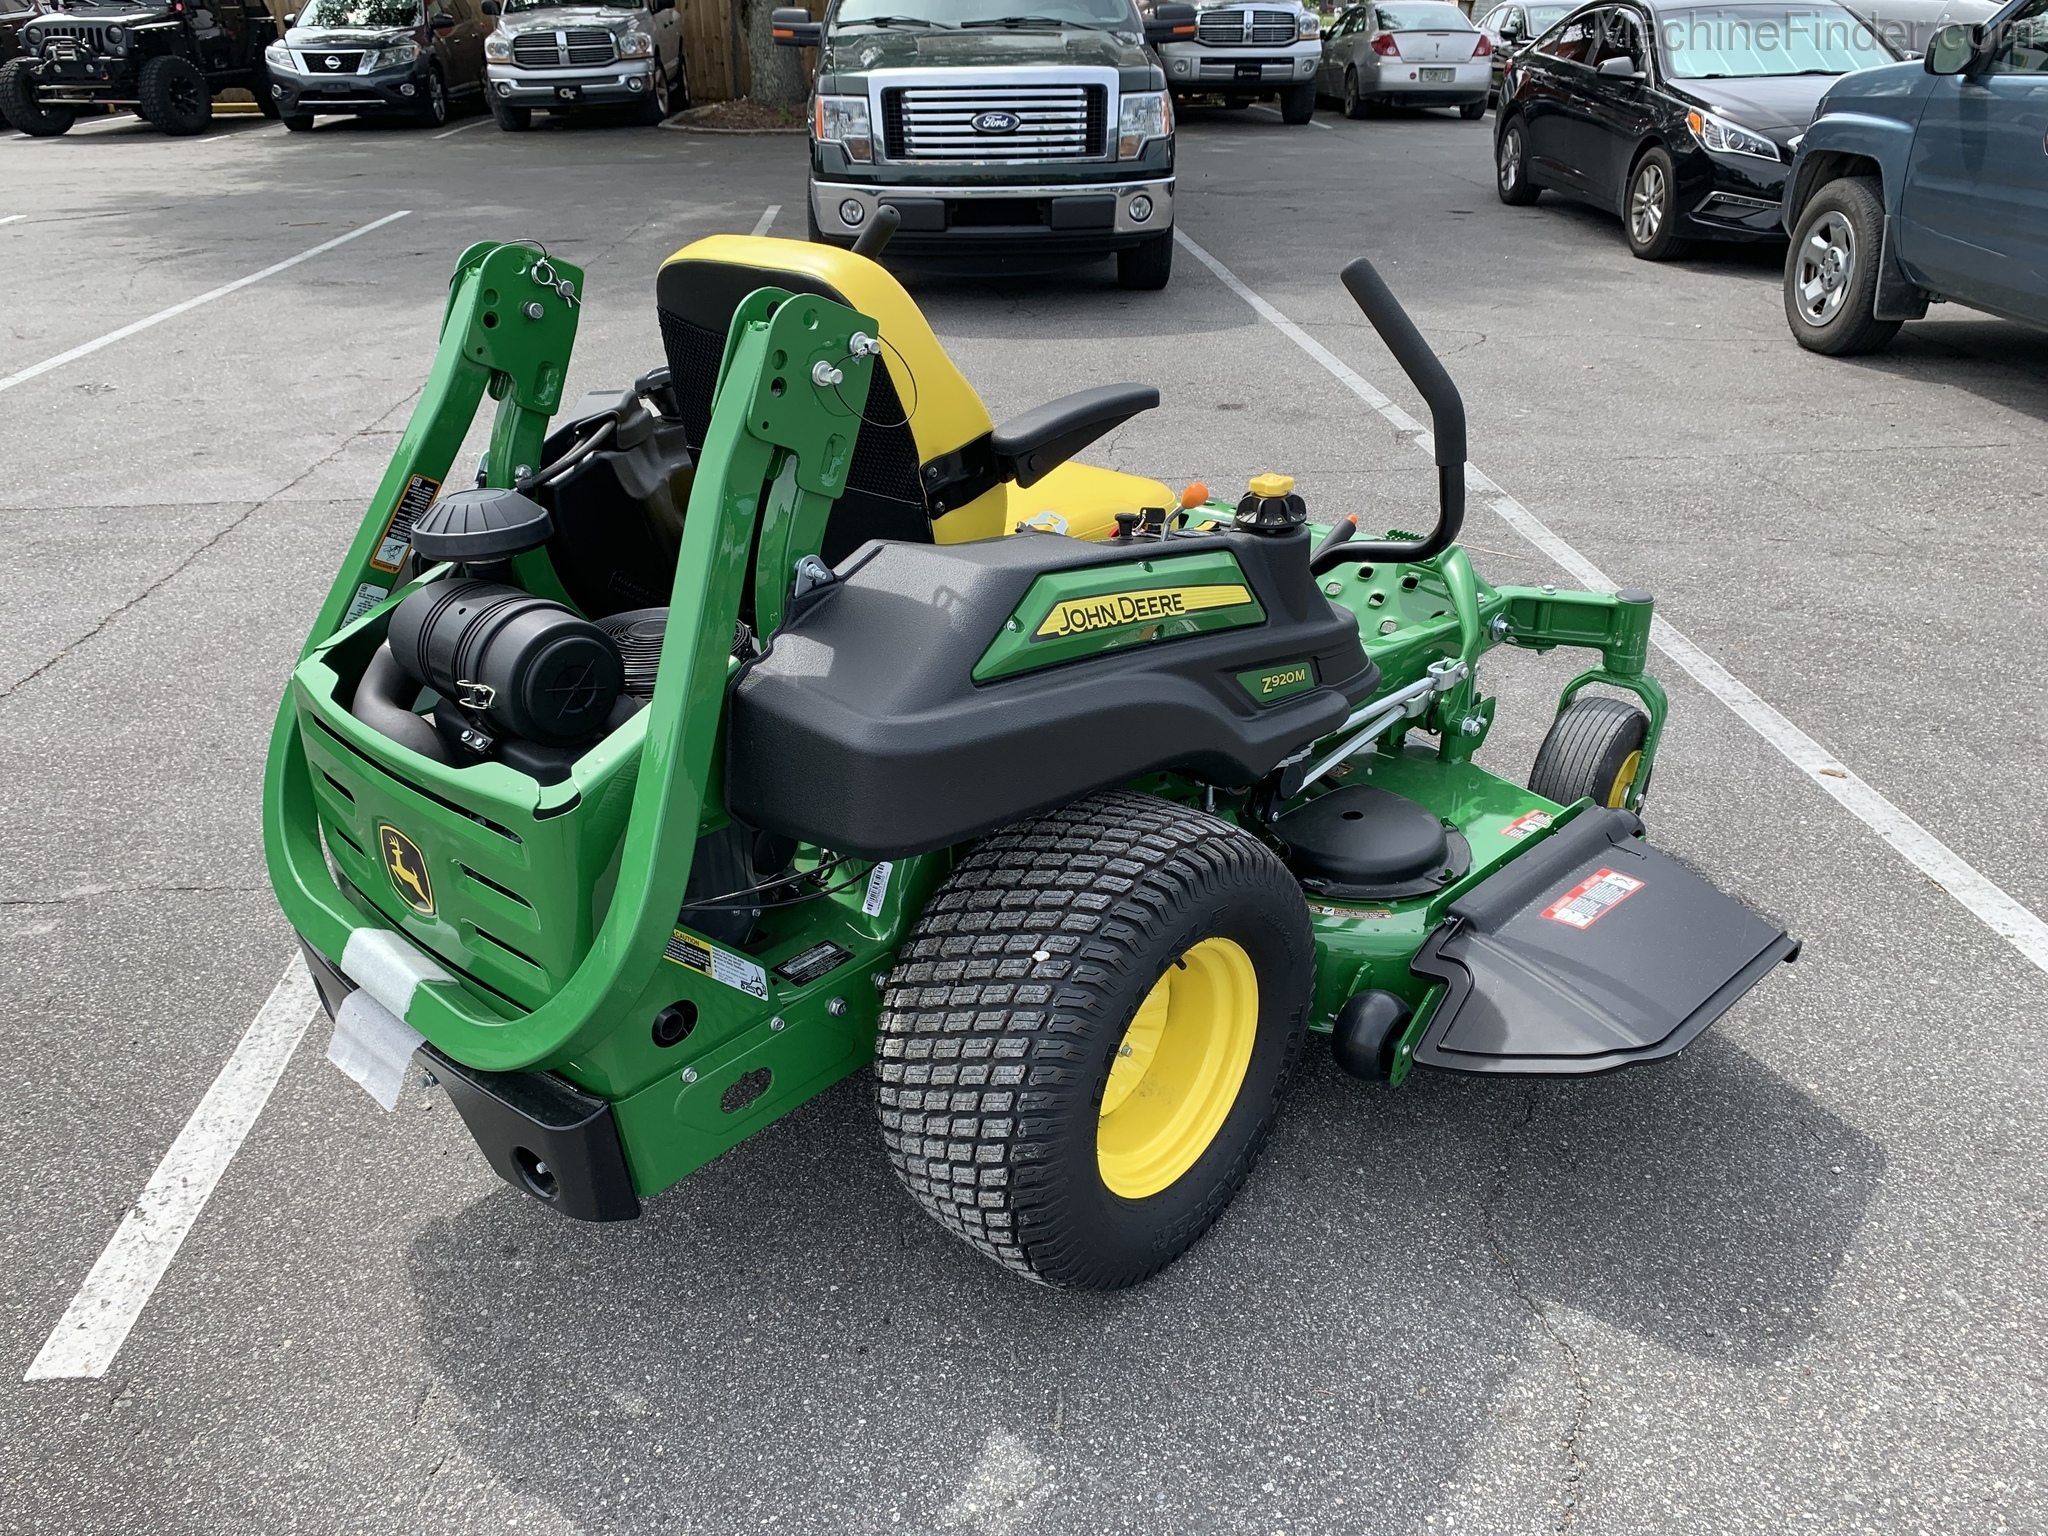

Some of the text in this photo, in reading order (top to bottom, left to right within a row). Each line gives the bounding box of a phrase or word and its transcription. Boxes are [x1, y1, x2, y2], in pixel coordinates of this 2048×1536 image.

[982, 114, 1009, 128] Ford
[1059, 593, 1185, 632] JOHN DEERE
[1261, 668, 1306, 694] Z920M
[675, 931, 700, 947] CAUTION
